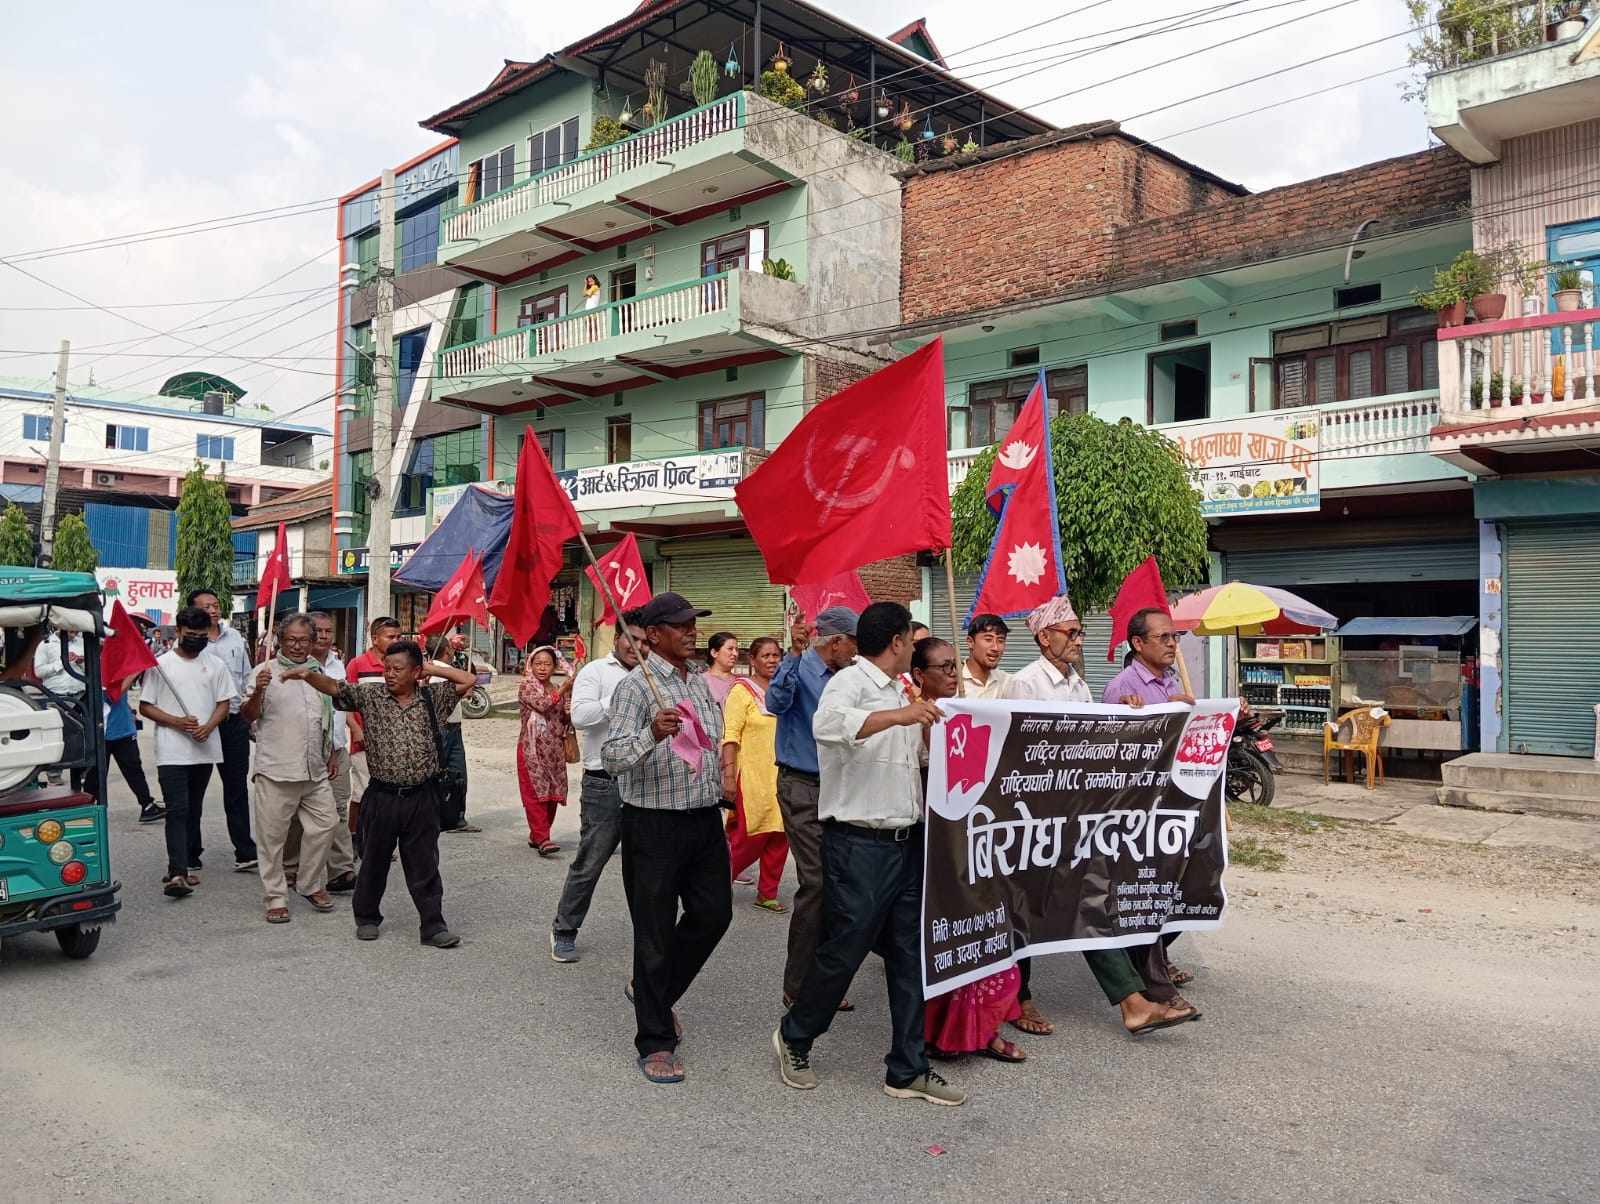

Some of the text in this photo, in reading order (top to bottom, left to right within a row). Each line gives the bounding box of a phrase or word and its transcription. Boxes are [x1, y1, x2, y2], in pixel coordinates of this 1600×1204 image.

[127, 580, 175, 606] हुलास
[1120, 743, 1141, 761] रक्षा
[1055, 768, 1083, 791] MCC
[966, 796, 1200, 885] बिरोध प्रदर्शन
